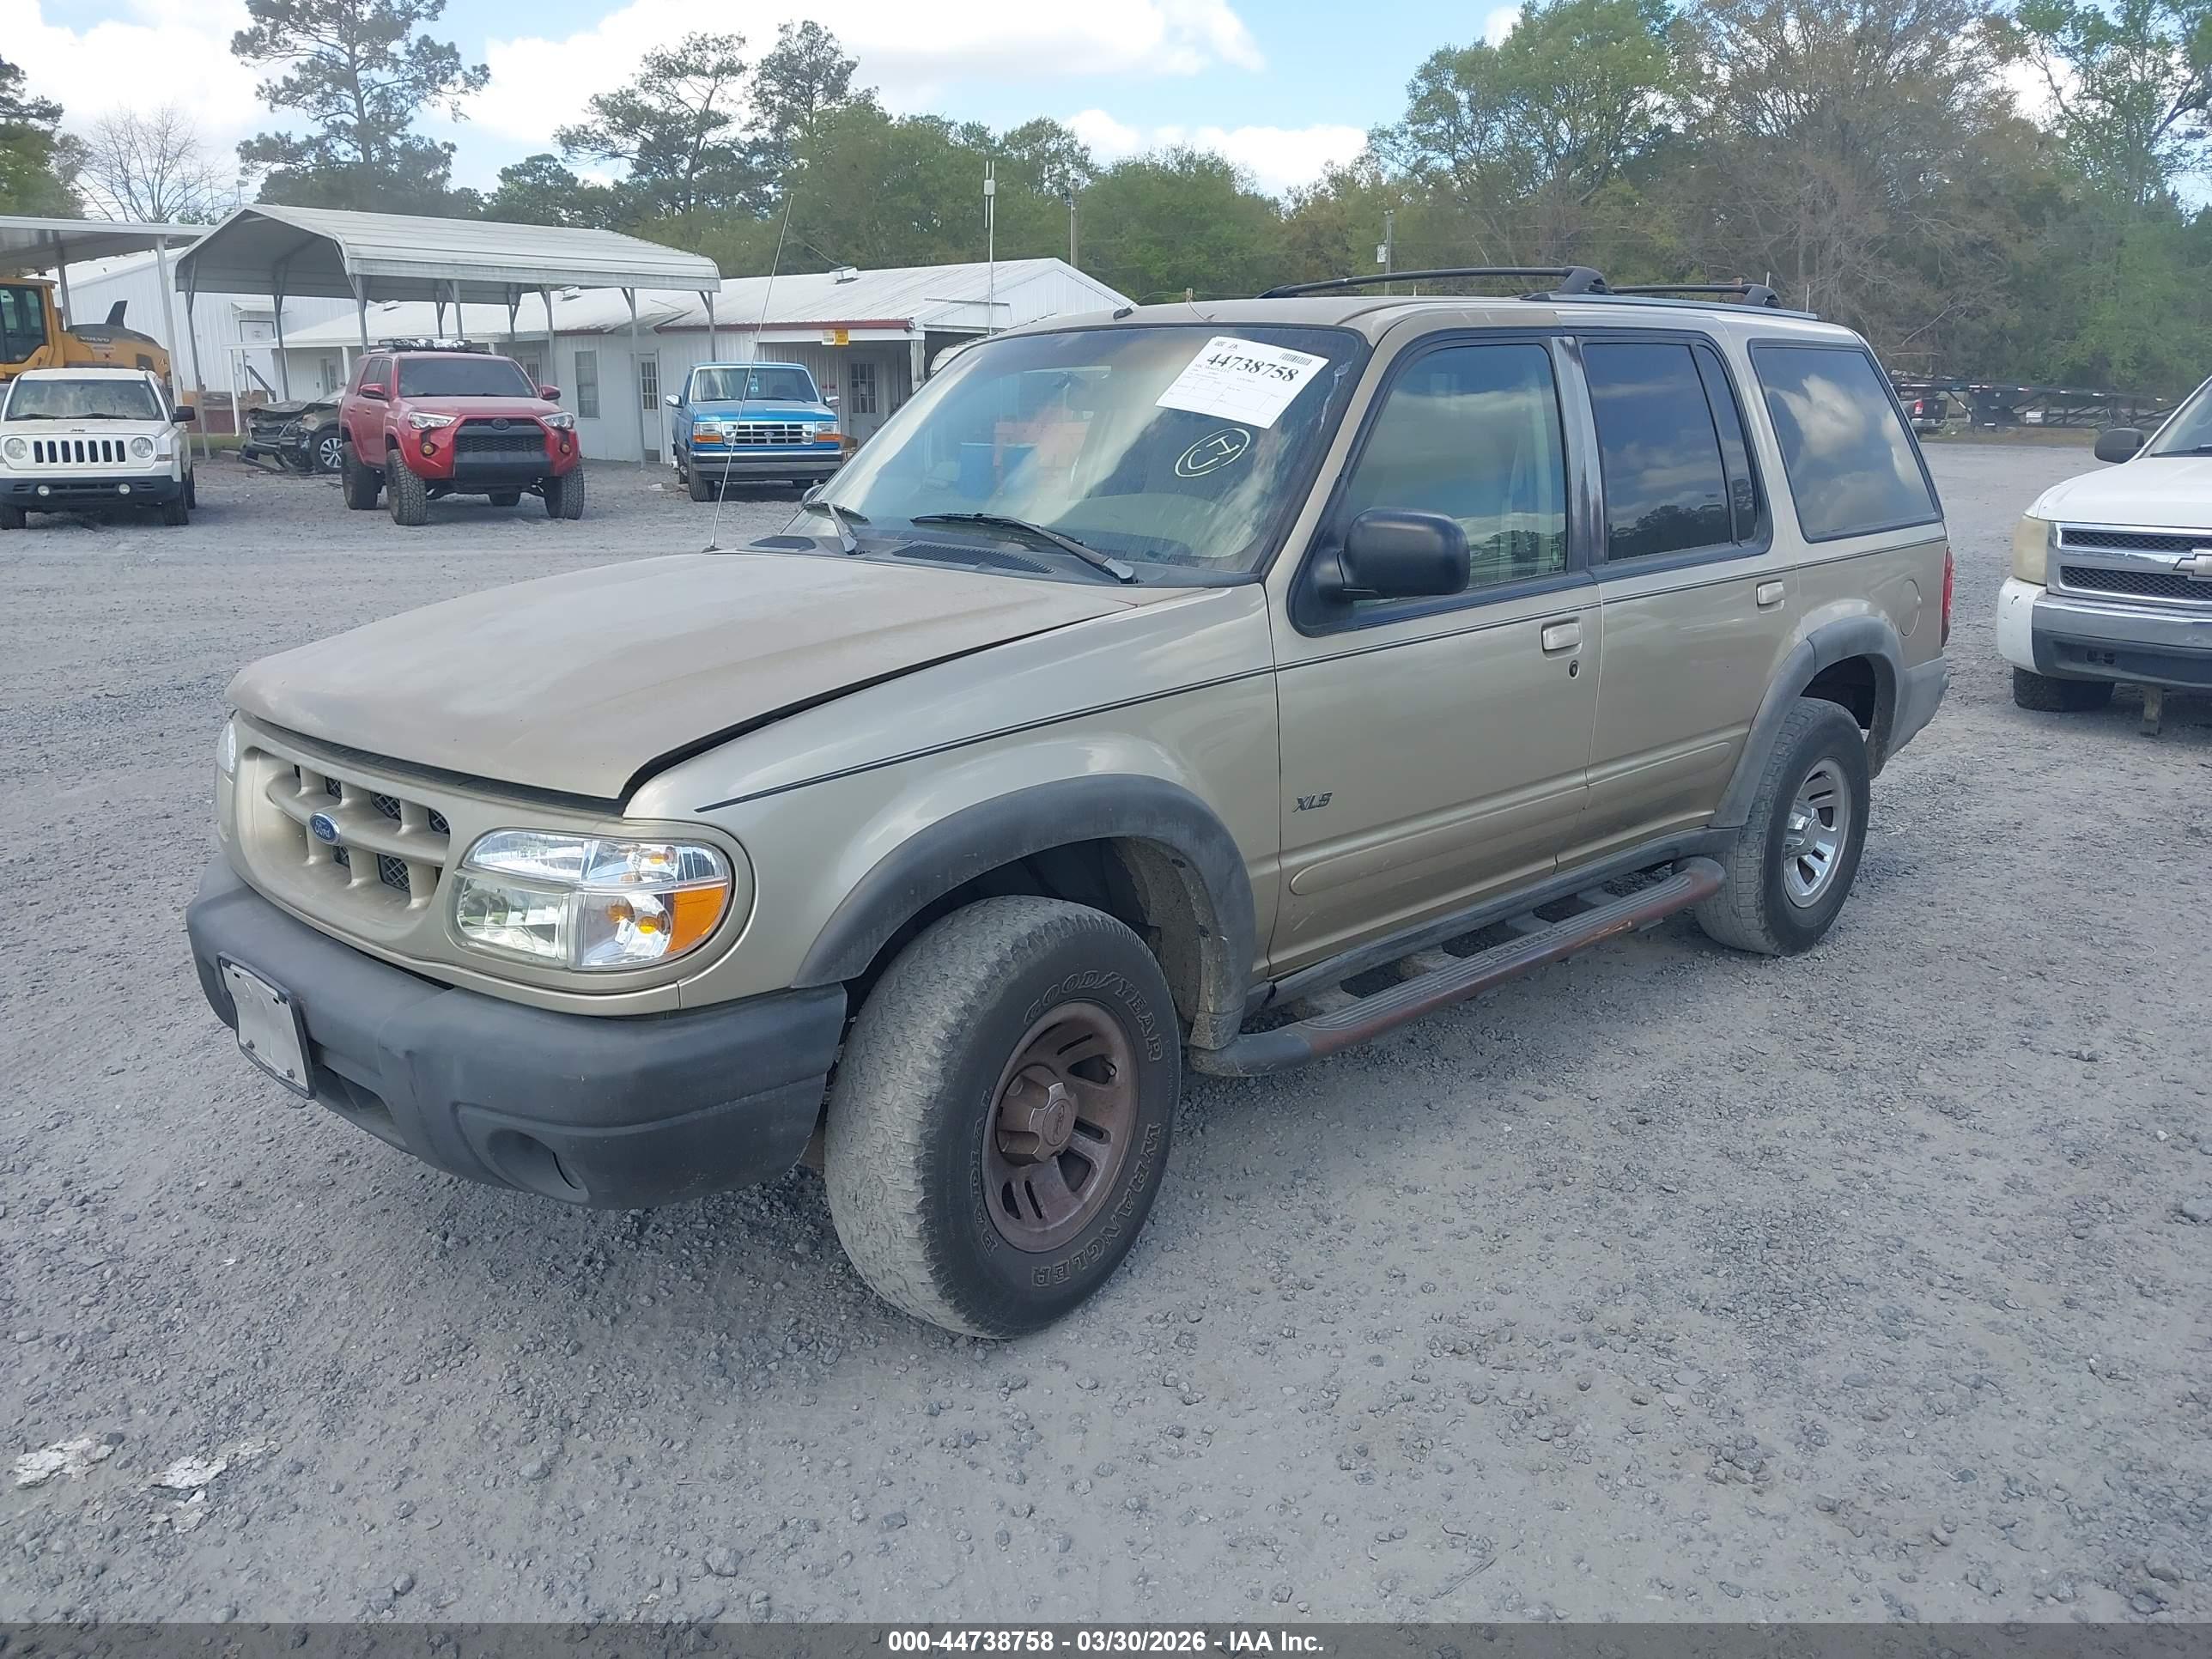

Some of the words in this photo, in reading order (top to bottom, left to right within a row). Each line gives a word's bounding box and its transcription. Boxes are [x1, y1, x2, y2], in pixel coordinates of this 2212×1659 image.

[1206, 353, 1299, 382] 44738758
[1291, 791, 1334, 813] XLS
[1033, 1122, 1163, 1288] WRANGLER
